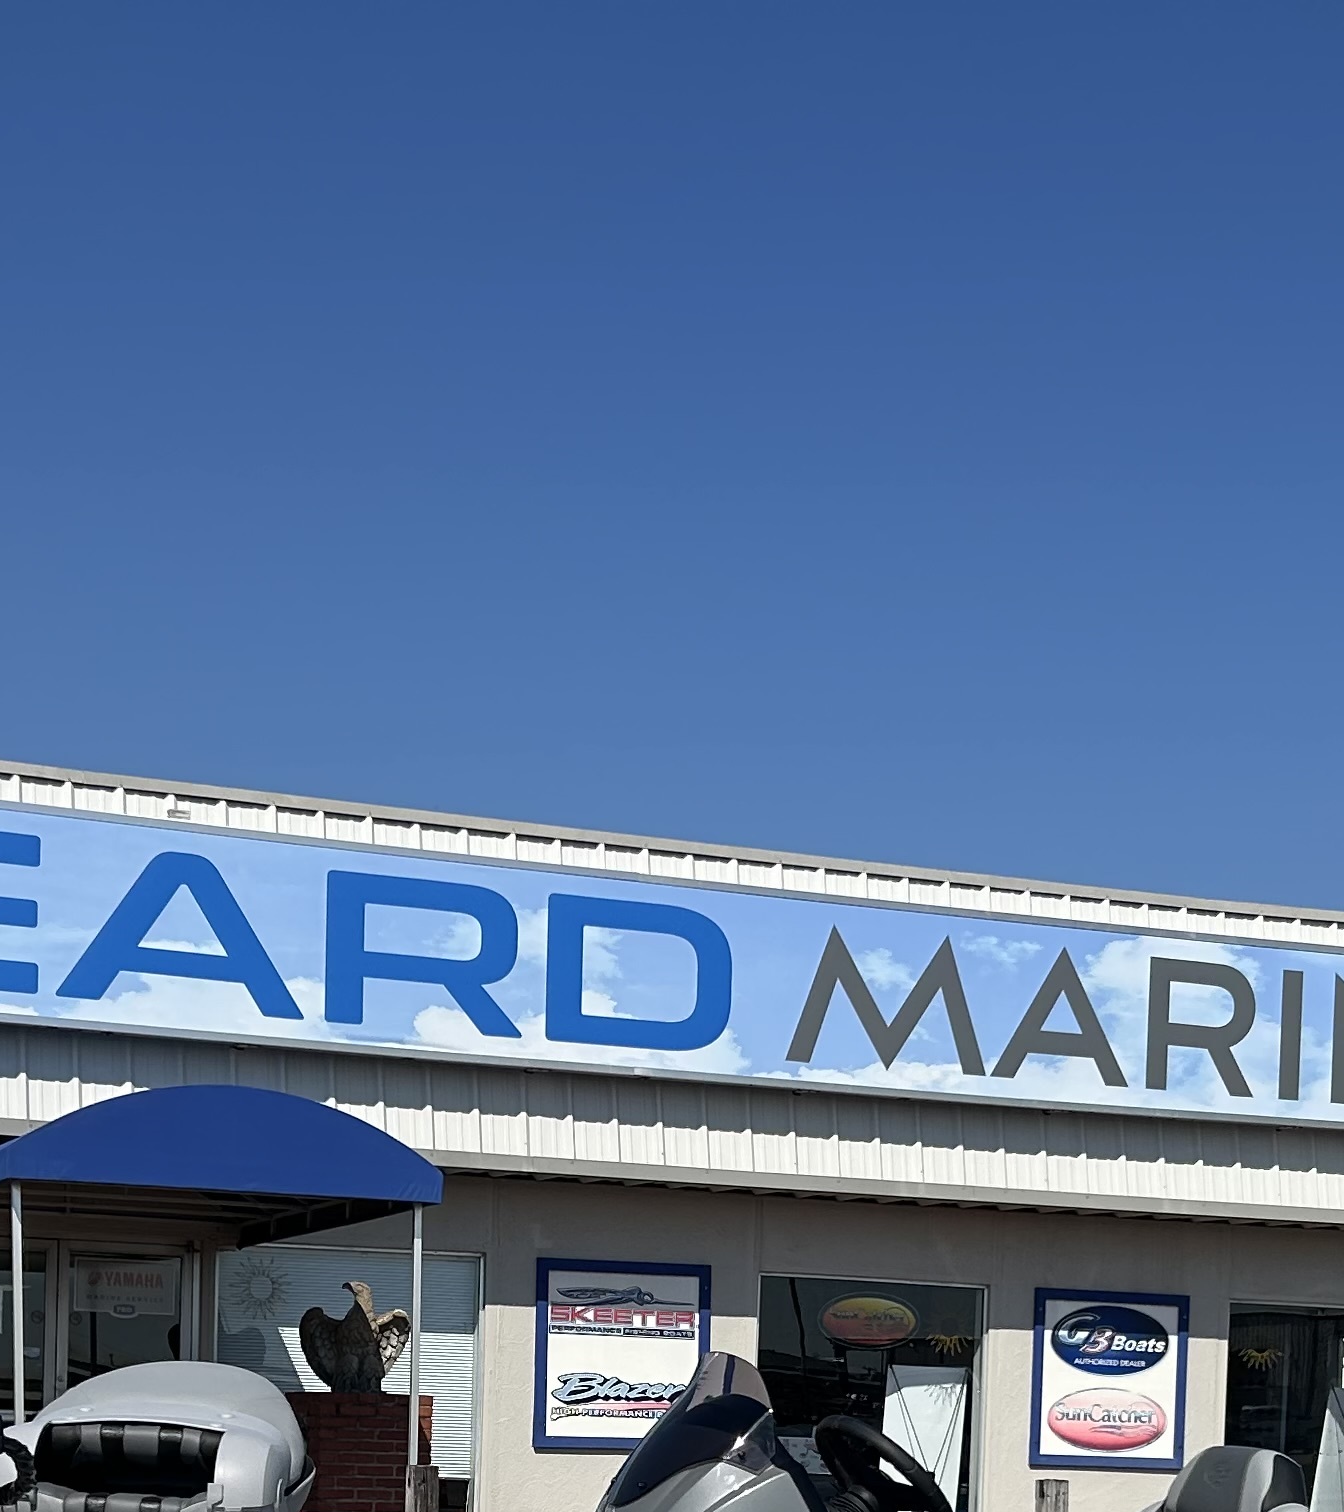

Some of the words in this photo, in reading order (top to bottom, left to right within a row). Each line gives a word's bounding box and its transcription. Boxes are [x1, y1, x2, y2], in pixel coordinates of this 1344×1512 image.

[104, 1271, 164, 1289] YAMAHA
[550, 1305, 696, 1330] SKEETER
[551, 1325, 623, 1334] PERFORMANCE
[1110, 1335, 1167, 1353] Boats
[1073, 1357, 1120, 1367] AUTHORIZED
[1120, 1359, 1147, 1368] DEALER
[551, 1372, 687, 1405] Blazer
[1055, 1402, 1155, 1424] SunCatcher
